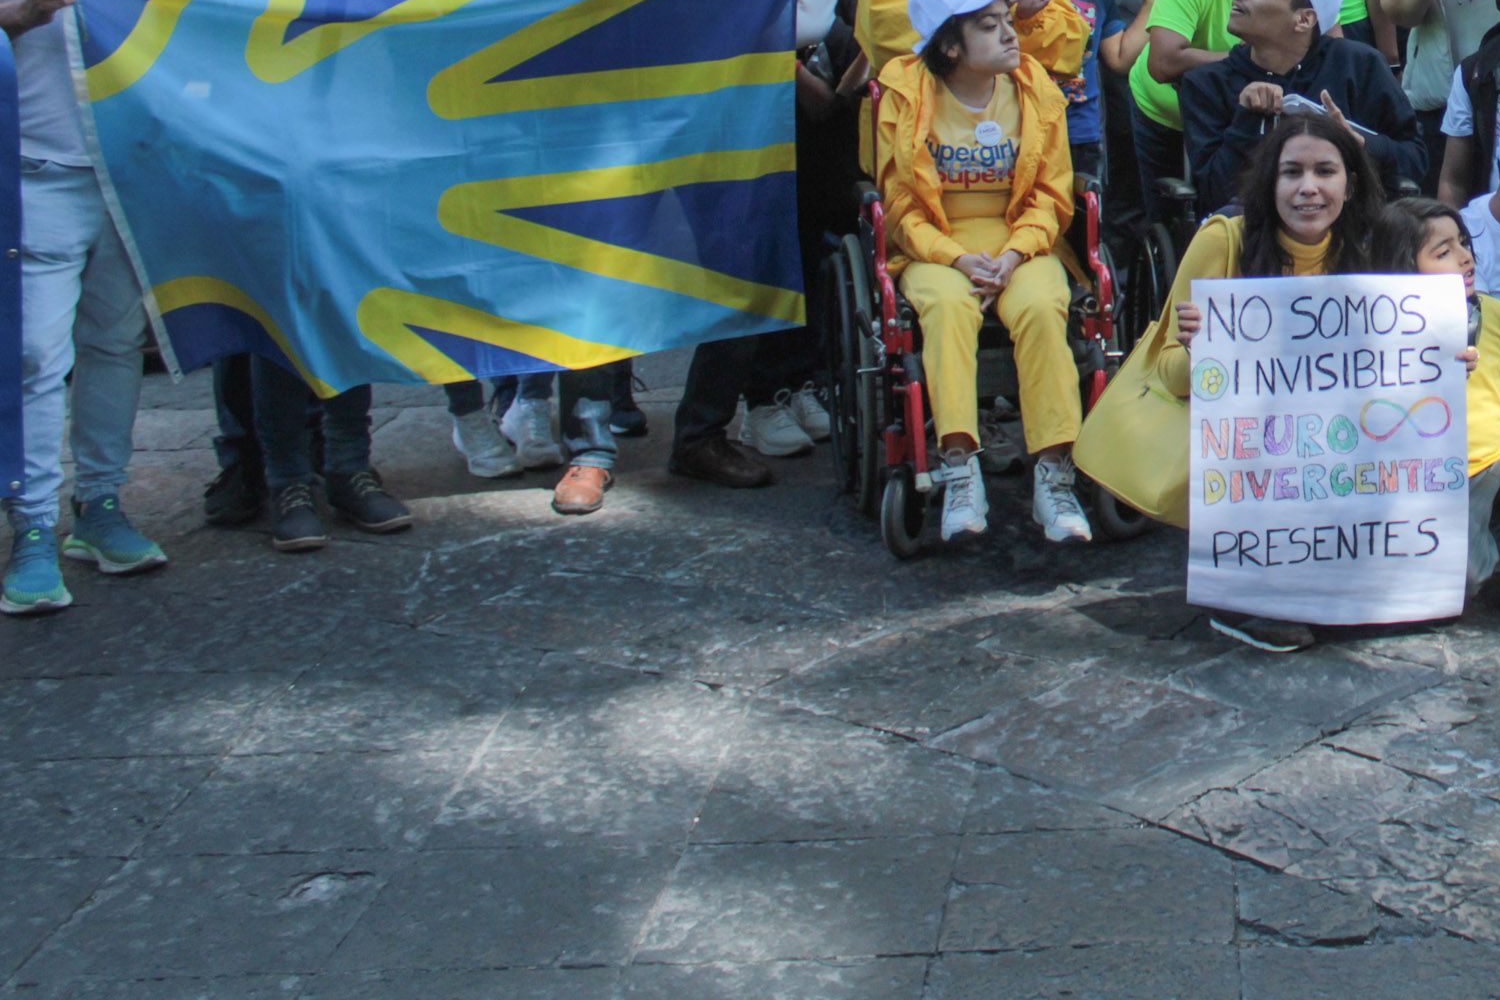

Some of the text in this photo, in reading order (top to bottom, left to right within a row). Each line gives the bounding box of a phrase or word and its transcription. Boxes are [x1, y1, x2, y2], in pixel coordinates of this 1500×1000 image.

[925, 138, 1016, 168] upergirl
[1207, 292, 1427, 342] NO SOMOS
[1201, 413, 1360, 460] NEURO
[1203, 457, 1466, 506] DIVERGENTES
[1212, 518, 1440, 569] PRESENTES
